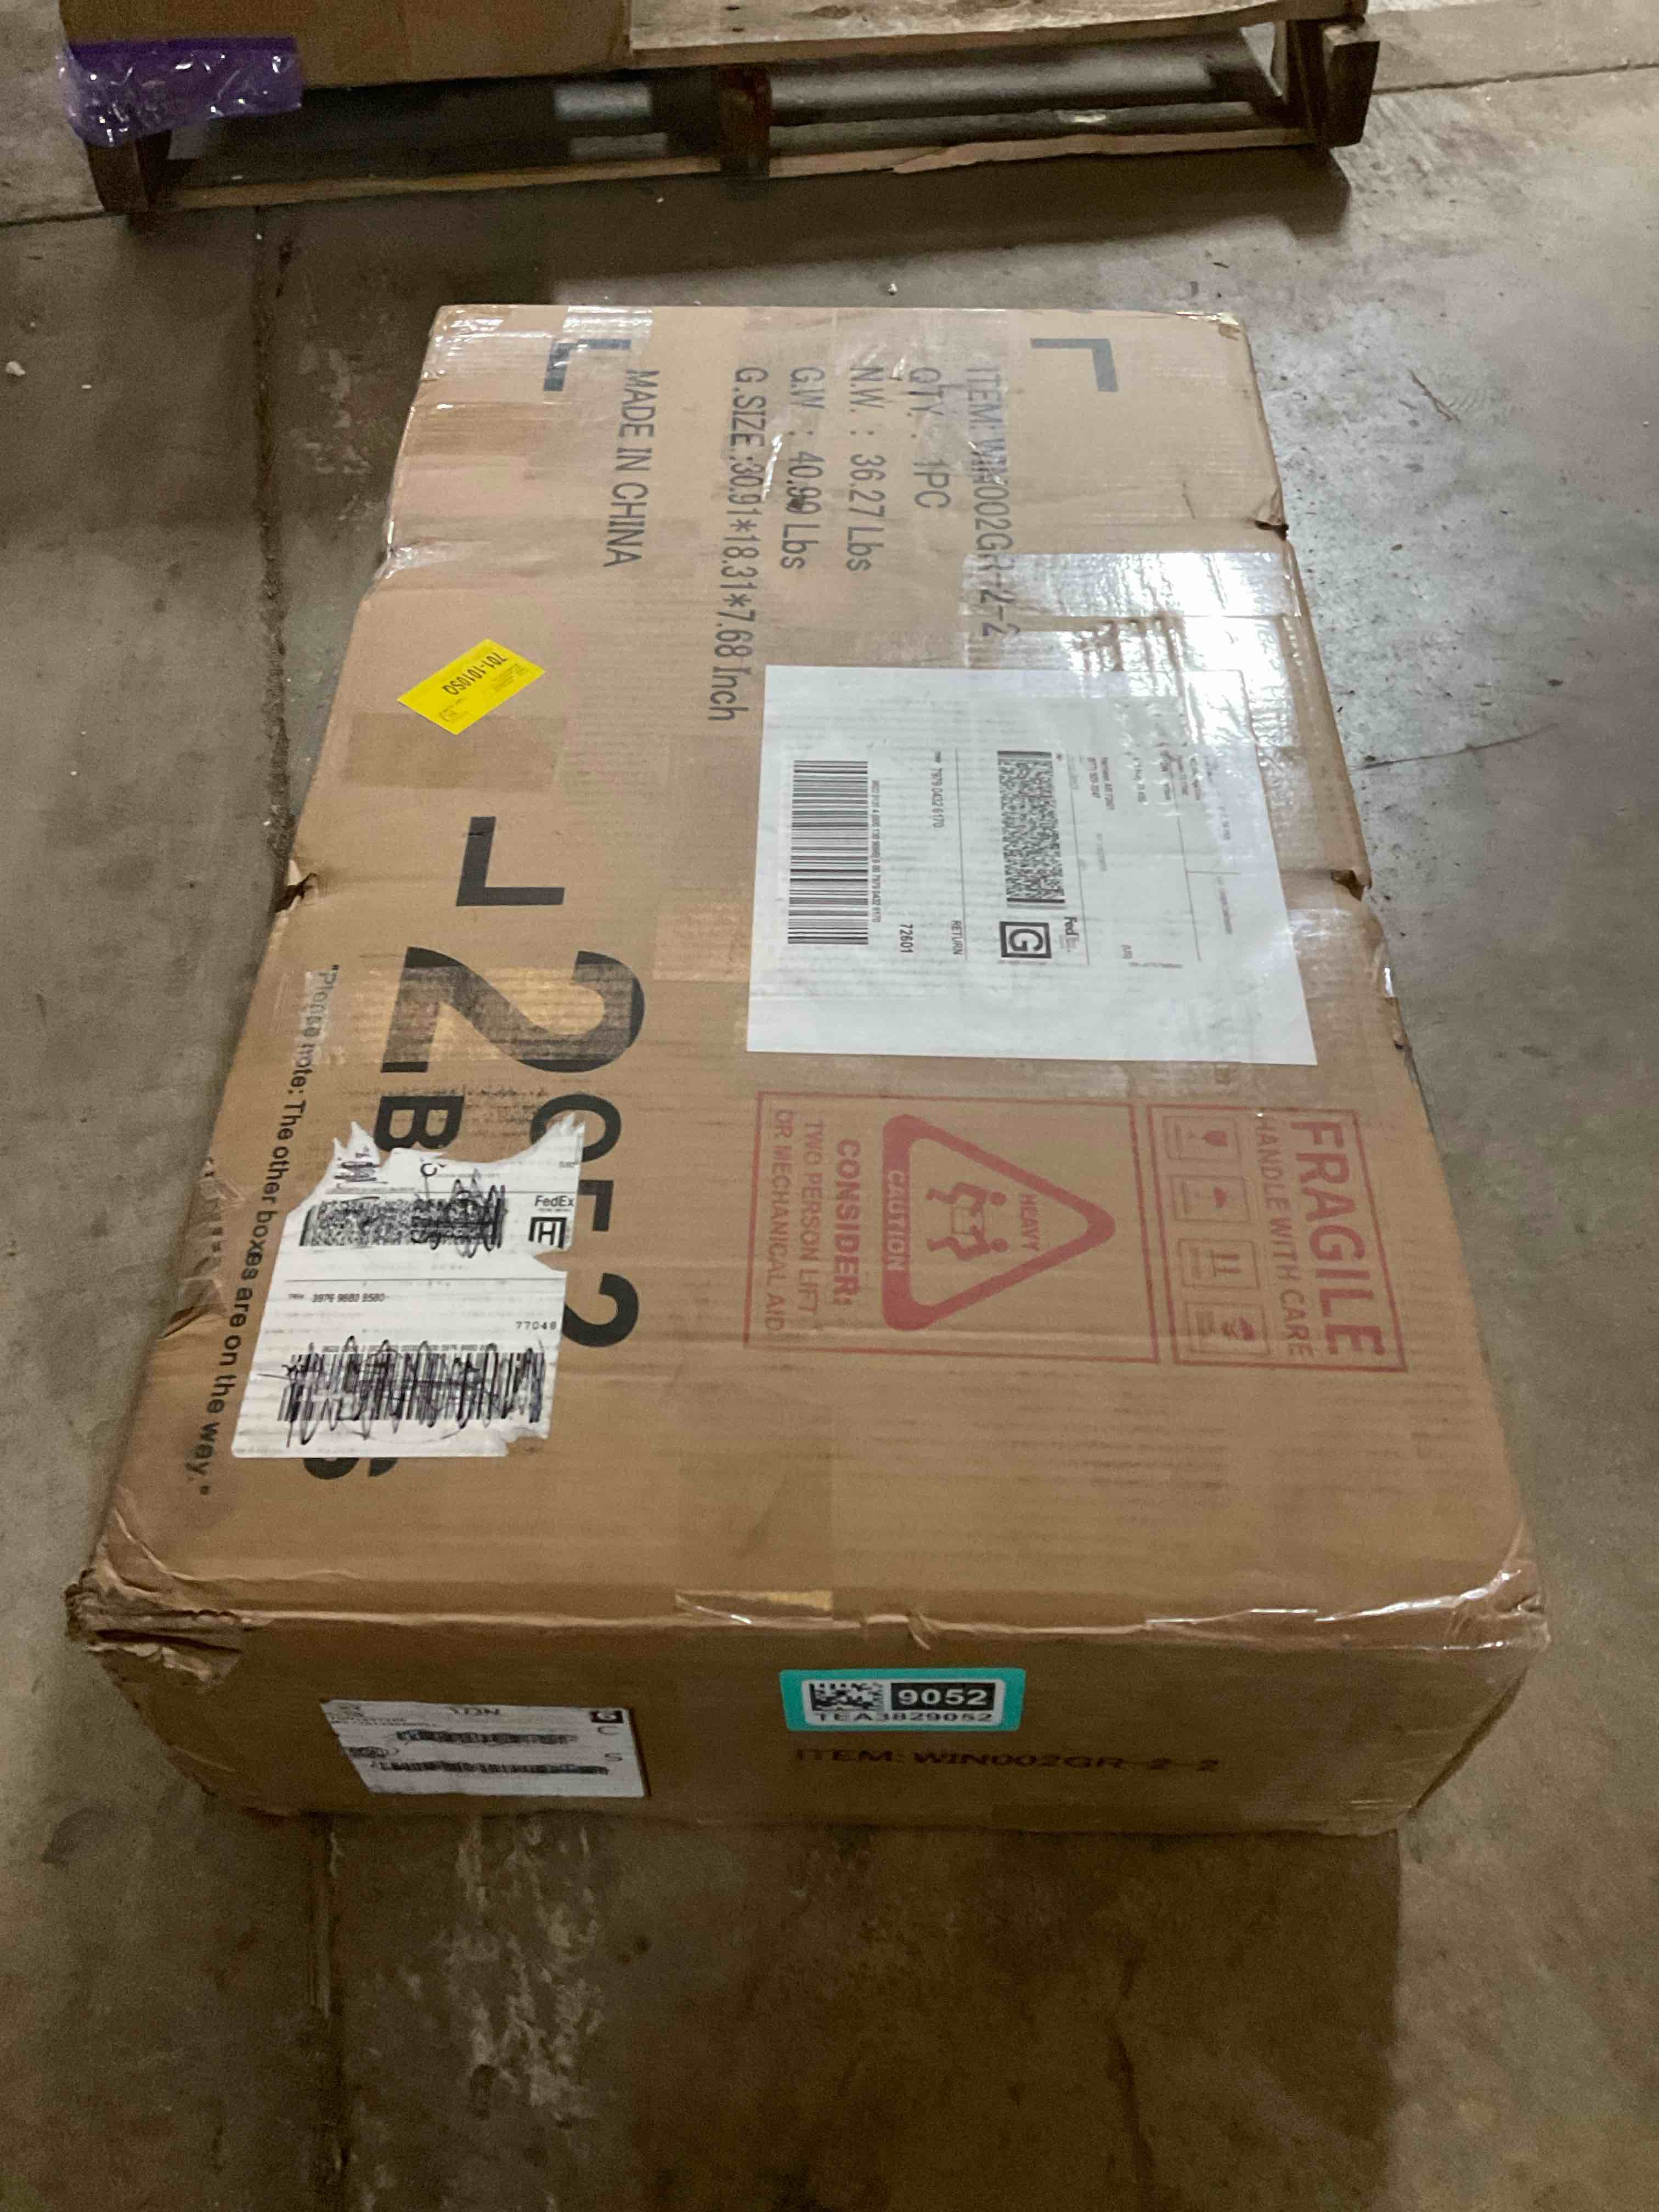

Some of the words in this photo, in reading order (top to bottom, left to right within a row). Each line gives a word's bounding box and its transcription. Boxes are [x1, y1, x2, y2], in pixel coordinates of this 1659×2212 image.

[618, 369, 661, 439] MADE
[849, 367, 885, 413] N.W.
[966, 368, 1003, 430] ITEM:
[616, 447, 653, 472] IN
[912, 459, 951, 509] 1PC
[848, 453, 887, 518] 36.27
[603, 482, 648, 568] CHINA
[781, 523, 820, 569] Lbs
[846, 526, 884, 572] Lbs
[708, 665, 751, 721] Inch
[899, 924, 913, 953] 72601
[951, 920, 963, 955] RETURN
[1009, 928, 1043, 952] G
[380, 946, 645, 1073] 2
[287, 1043, 317, 1094] note:
[276, 1100, 306, 1141] The
[775, 1109, 795, 1138] OR
[804, 1120, 823, 1165] TWO
[261, 1146, 291, 1204] other
[1254, 1116, 1293, 1211] HANDLE
[534, 1195, 575, 1208] FedEx
[767, 1144, 792, 1290] MECHANICAL
[799, 1172, 822, 1261] PERSON
[833, 1139, 861, 1305] CONSIDER:
[887, 1170, 906, 1271] CAUTION
[1019, 1193, 1040, 1252] HEAVY
[241, 1210, 279, 1280] boxes
[1269, 1216, 1302, 1281] WITH
[1290, 1121, 1385, 1356] FRAGILE
[229, 1287, 254, 1328] are
[764, 1293, 786, 1331] AID
[797, 1268, 819, 1316] LIFT
[1279, 1289, 1314, 1357] CARE
[218, 1335, 242, 1367] on
[207, 1375, 238, 1414] the
[898, 1689, 987, 1705] 9052
[795, 1748, 904, 1763] ITEM:
